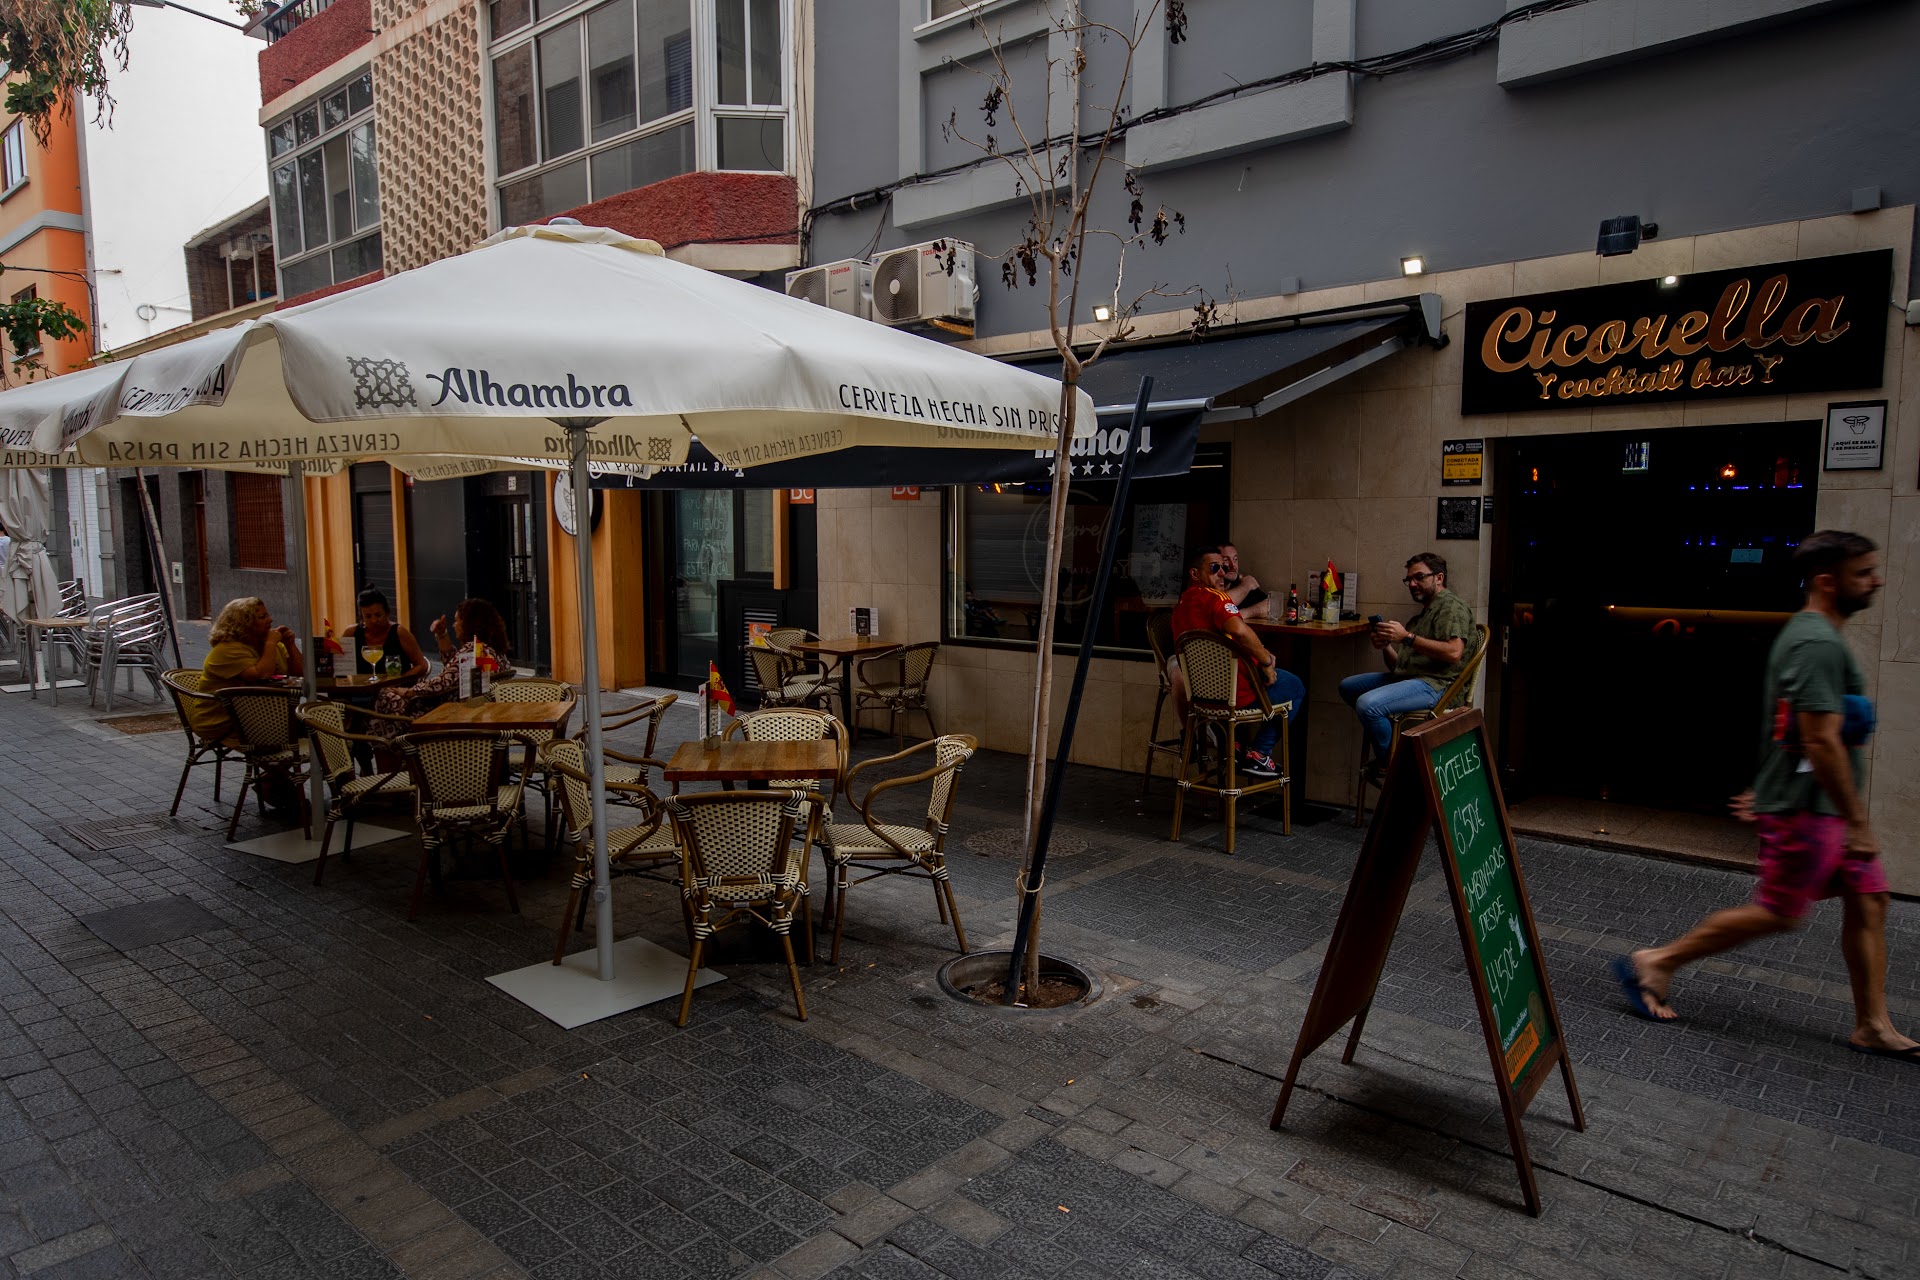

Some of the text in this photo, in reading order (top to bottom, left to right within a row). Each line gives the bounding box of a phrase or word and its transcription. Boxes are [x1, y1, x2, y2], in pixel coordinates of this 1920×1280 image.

[830, 267, 850, 275] TOSHIBA
[1481, 273, 1850, 373] Cicorella
[426, 367, 633, 408] Alhambra
[1557, 356, 1754, 400] cocktail bar
[838, 384, 1060, 434] CERVEZA HECHA SIN PRIS
[661, 461, 708, 473] OCKTAIL
[692, 518, 725, 531] HUEVOS
[1463, 844, 1506, 913] OMBINADOS
[1478, 895, 1506, 943] DESDE
